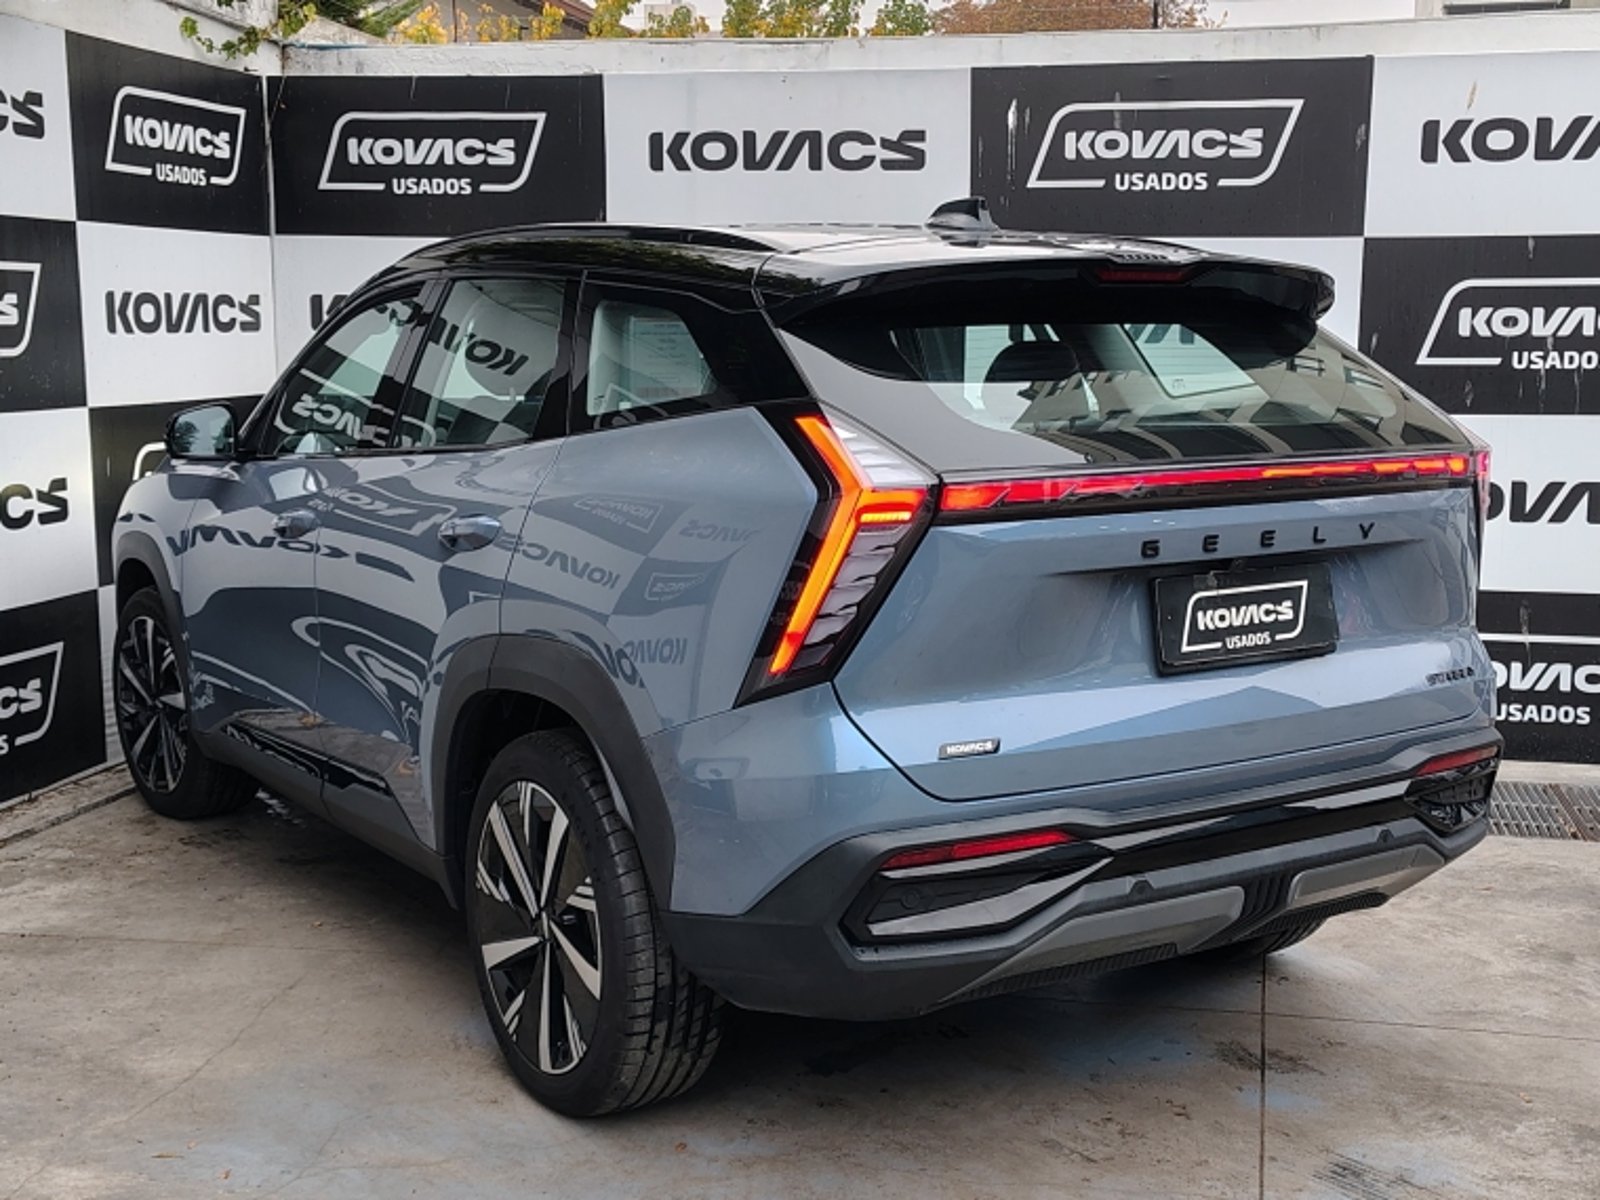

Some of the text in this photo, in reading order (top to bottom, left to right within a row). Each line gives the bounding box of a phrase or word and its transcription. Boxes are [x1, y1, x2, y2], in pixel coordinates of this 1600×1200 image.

[124, 114, 231, 159] KOVACS
[348, 137, 516, 166] KOVACS
[649, 129, 927, 171] KOVACS
[1065, 127, 1264, 160] KOVACS
[155, 163, 207, 187] USADOS
[392, 178, 472, 195] USADOS
[1115, 172, 1208, 191] USADOS
[106, 290, 261, 335] KOVACS
[1458, 306, 1600, 338] KOVA
[1140, 521, 1376, 559] GEELY
[1197, 599, 1295, 632] KOVACS
[1225, 630, 1272, 650] USADOS
[946, 740, 992, 755] KOVACS
